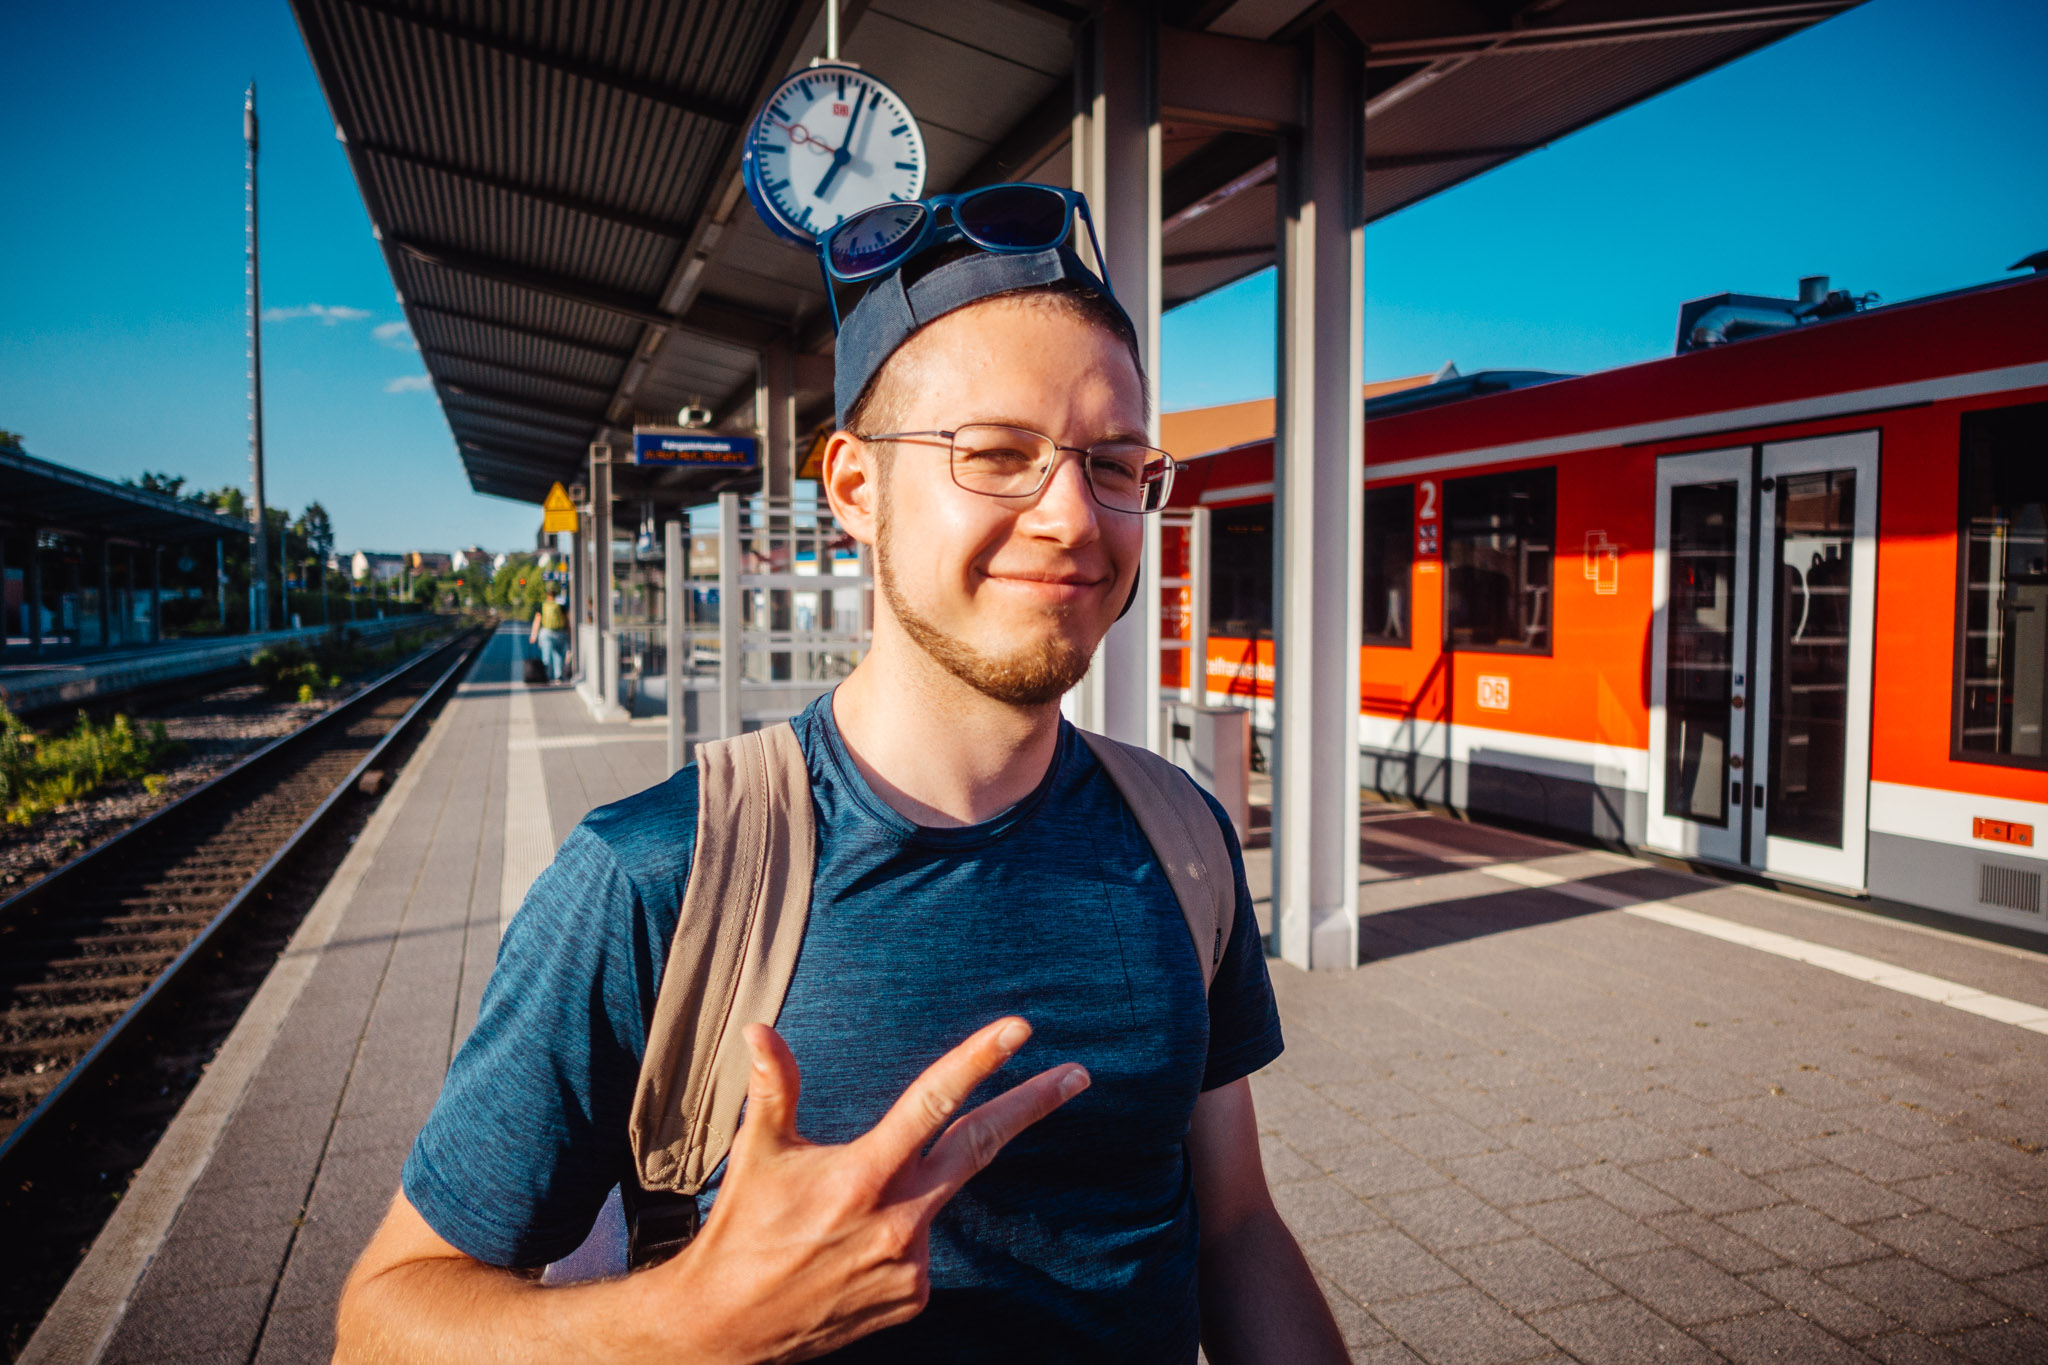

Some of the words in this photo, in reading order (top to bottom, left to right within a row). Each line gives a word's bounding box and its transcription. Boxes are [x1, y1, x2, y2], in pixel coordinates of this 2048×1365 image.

[833, 103, 849, 117] DB
[1419, 480, 1437, 520] 2
[1482, 679, 1507, 706] DB
